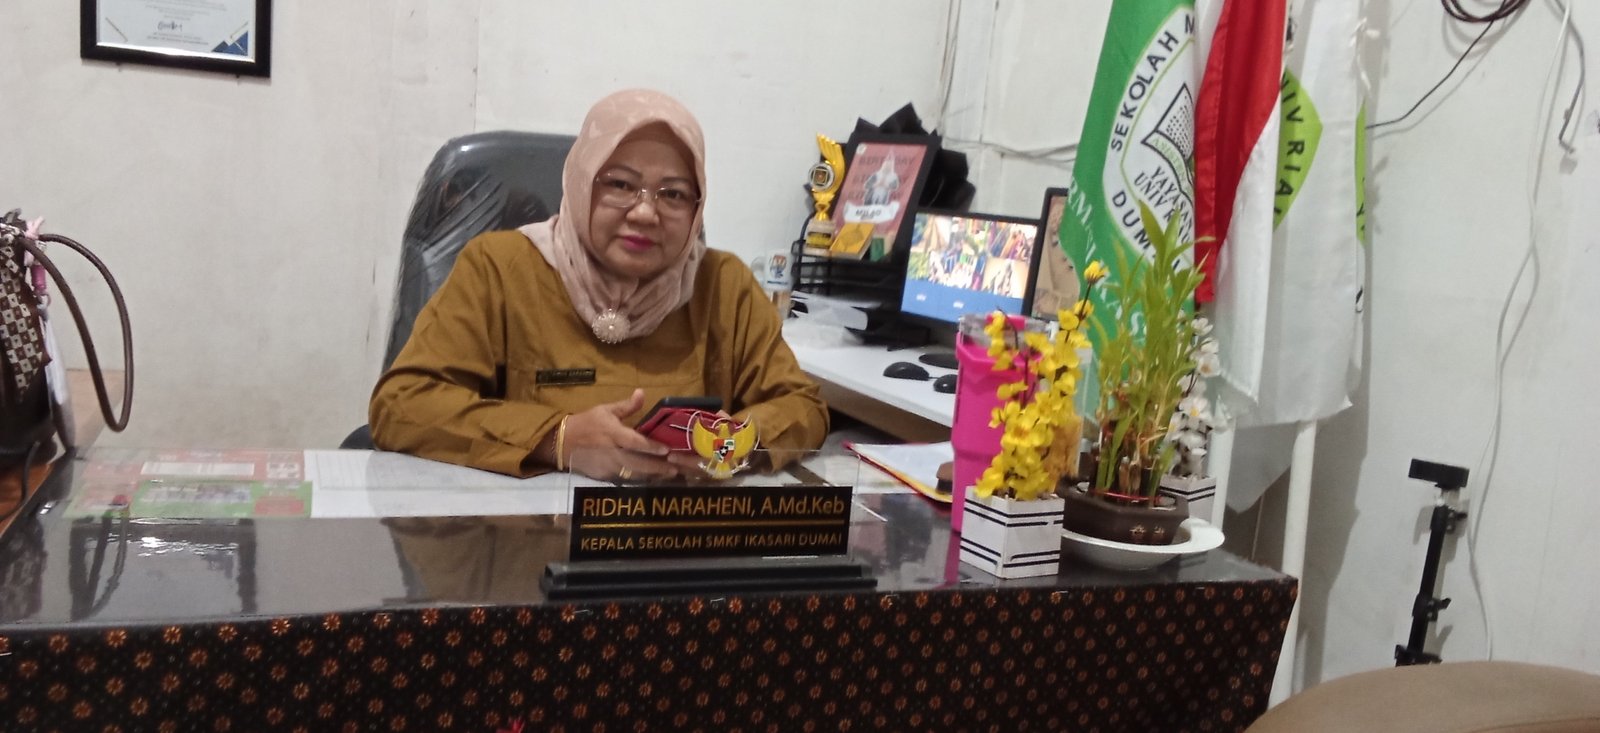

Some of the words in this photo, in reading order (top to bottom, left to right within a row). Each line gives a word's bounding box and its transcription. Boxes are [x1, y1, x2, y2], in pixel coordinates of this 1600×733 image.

[1110, 31, 1179, 152] SEKOLAH
[1134, 171, 1168, 208] UNIV
[1112, 190, 1181, 271] DUMI
[583, 497, 646, 517] RIDHA
[652, 496, 756, 518] NARAHENI,
[760, 495, 845, 515] A.Md.Keb
[581, 536, 635, 551] KEPALA
[639, 534, 702, 549] SEKOLAH
[706, 534, 740, 548] SMKF
[745, 533, 796, 547] IKASARI
[800, 532, 842, 546] DUMAI
